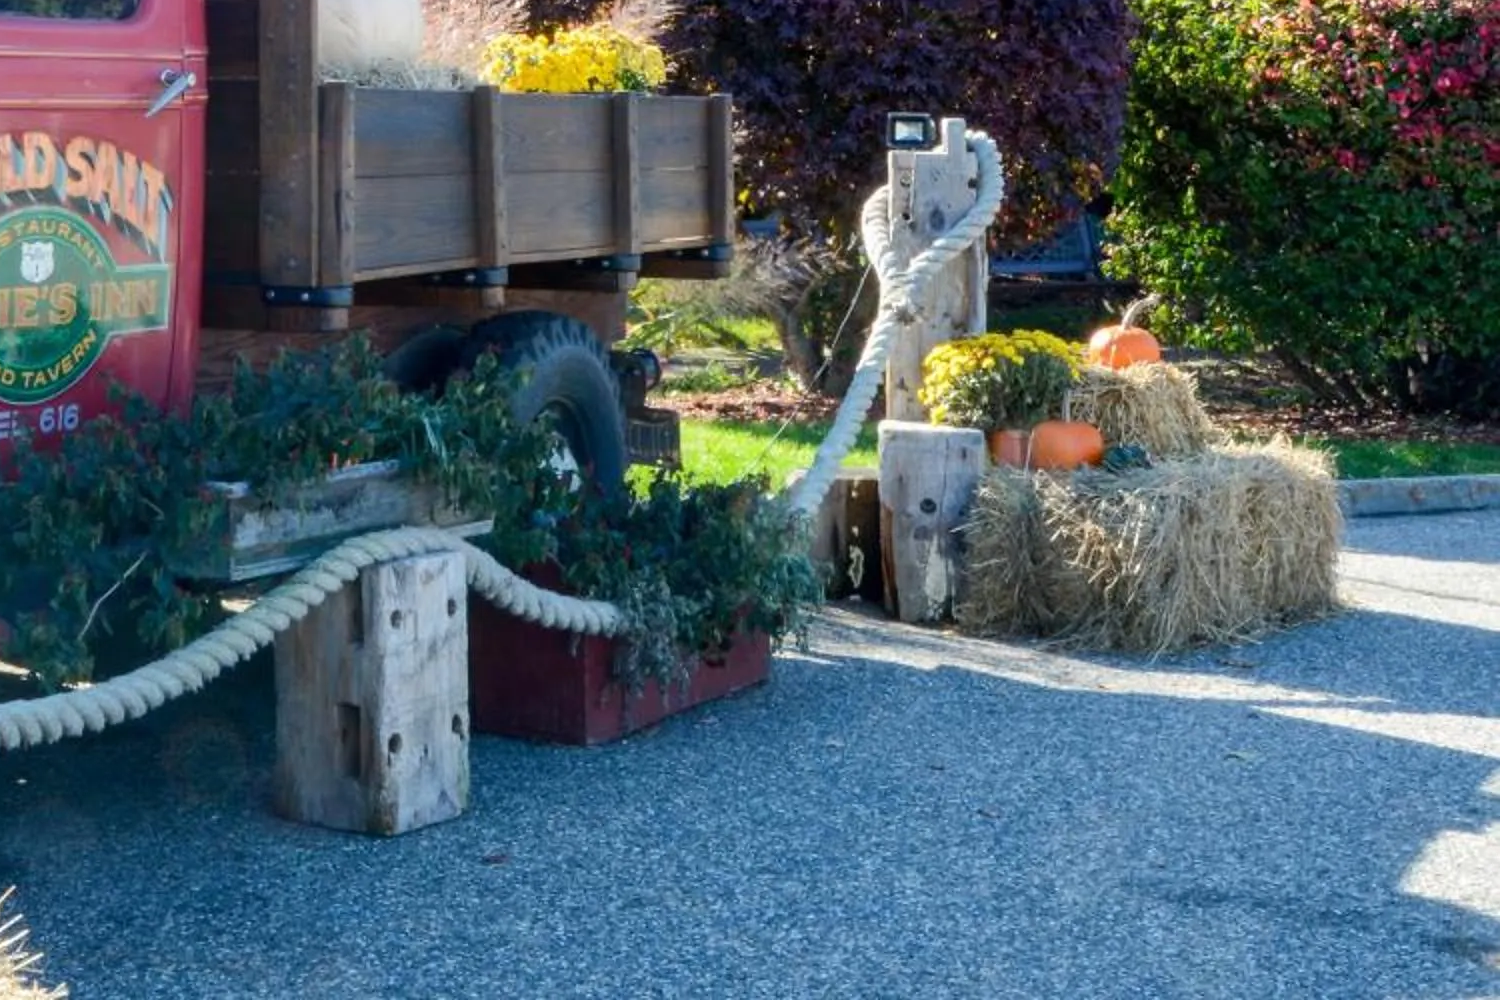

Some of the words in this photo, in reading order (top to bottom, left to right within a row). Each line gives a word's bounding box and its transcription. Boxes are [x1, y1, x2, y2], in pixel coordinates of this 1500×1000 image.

[64, 135, 170, 255] SALT
[88, 278, 158, 321] INN
[21, 328, 97, 388] TAVERN
[39, 403, 80, 434] 616
